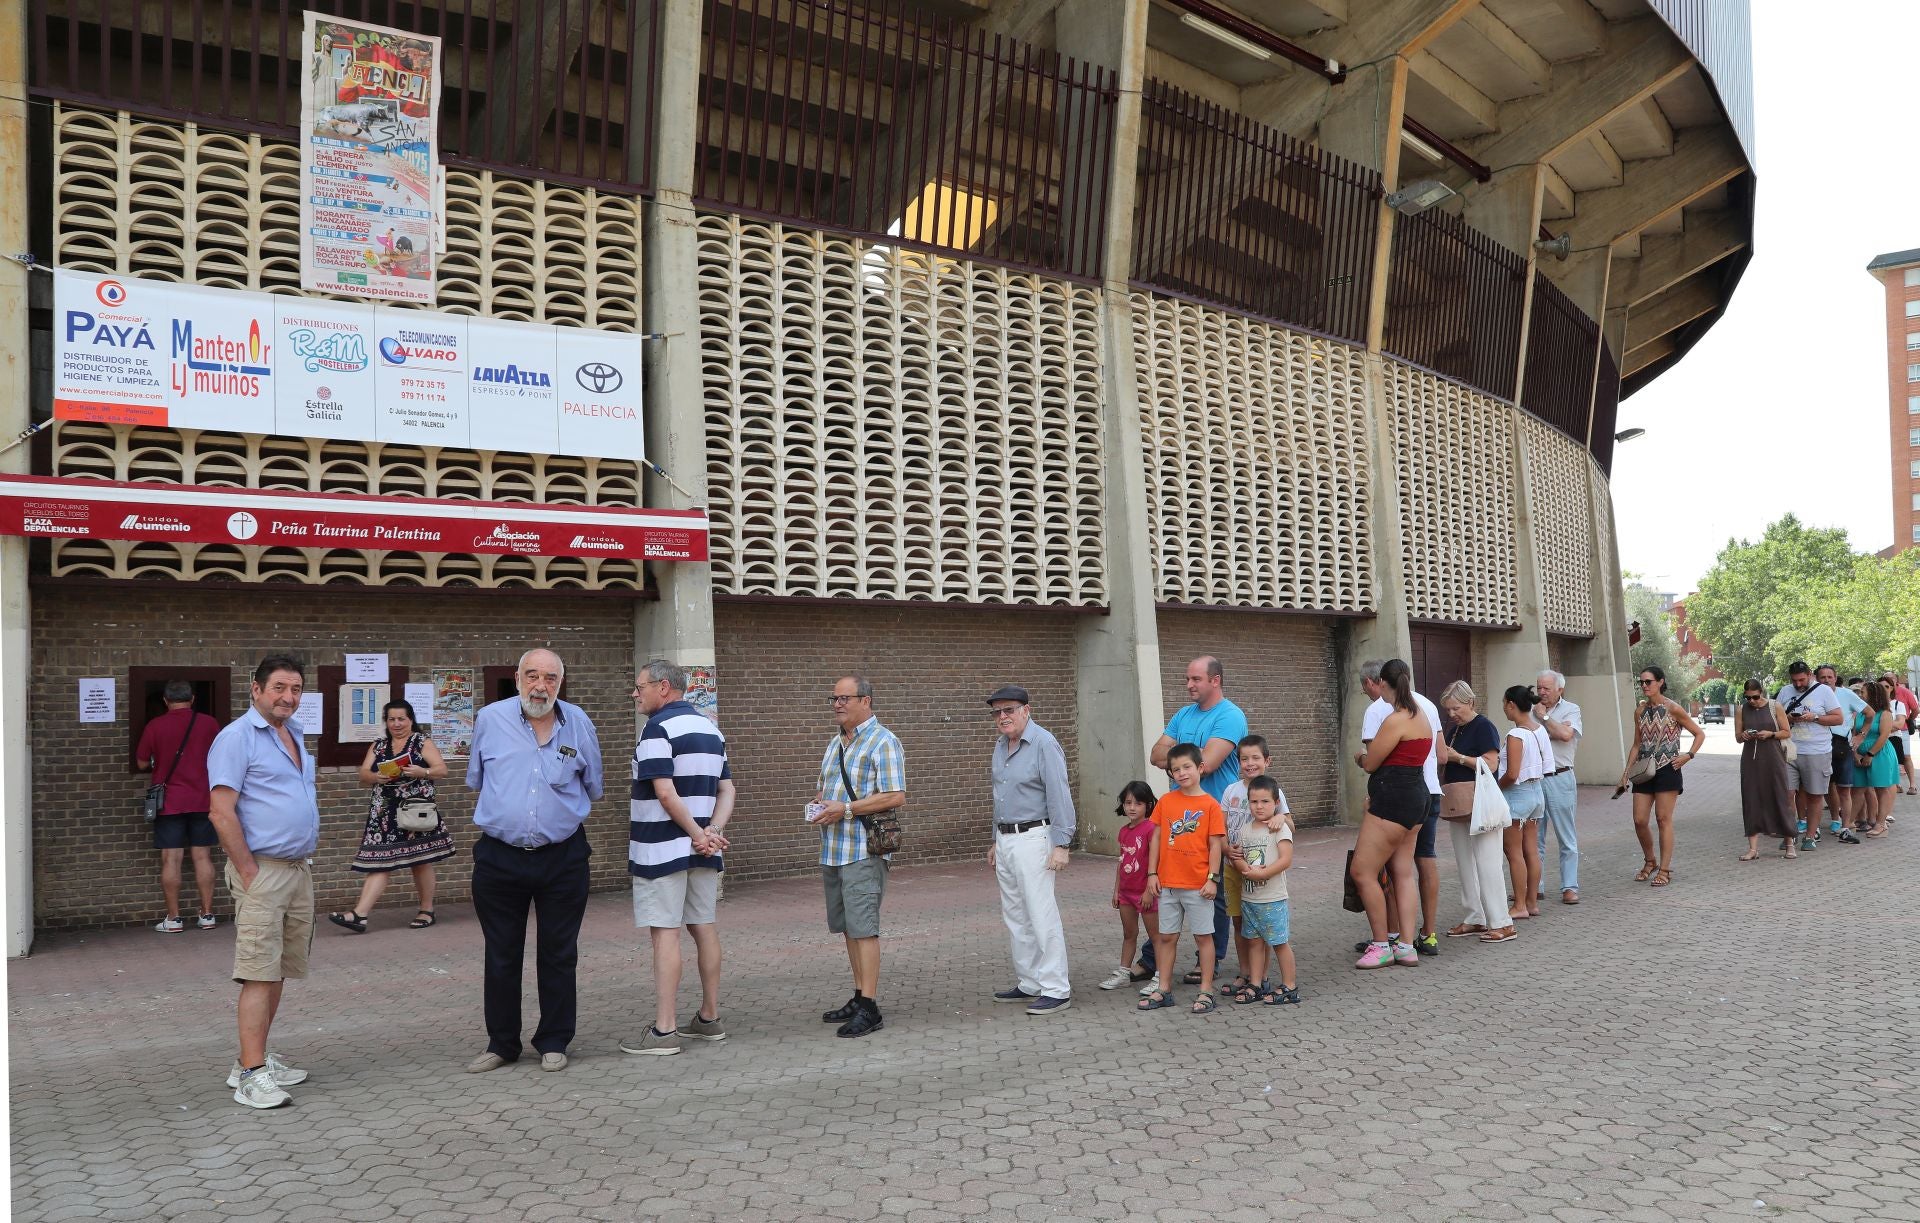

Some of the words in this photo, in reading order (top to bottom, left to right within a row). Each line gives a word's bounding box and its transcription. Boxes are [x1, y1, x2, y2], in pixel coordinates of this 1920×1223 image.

[379, 120, 416, 143] SAN
[316, 153, 343, 163] EMILIO
[333, 150, 364, 160] PERERA
[402, 150, 428, 172] 2025
[316, 160, 358, 171] CLEMENTE
[330, 181, 366, 190] FERNANDES
[316, 190, 352, 201] DUARTE
[354, 197, 385, 205] FERNANDES
[336, 187, 374, 197] VENTURA
[315, 210, 355, 220] MORANTE
[315, 216, 372, 228] MANZANARES
[336, 225, 370, 234] AGUADO
[315, 245, 362, 256] TALAVANTE
[315, 252, 339, 260] ROCA
[345, 261, 367, 269] RUFO
[315, 282, 429, 299] www.torospalencia.es
[98, 312, 143, 323] Comercial
[283, 317, 359, 332] DISTRIBUCIONES
[399, 330, 457, 347] TELECOMUNICACIONES
[288, 328, 368, 362] R&M
[63, 352, 132, 365] DISTRIBUIDOR
[136, 358, 148, 366] DE
[393, 345, 457, 361] ALVARO
[63, 362, 124, 374] PRODUCTOS
[128, 368, 153, 376] PARA
[318, 358, 360, 371] HOSTELERIA
[63, 372, 102, 382] HIGIENE
[116, 377, 160, 386] LIMPIEZA
[172, 363, 187, 397] LJ
[473, 364, 551, 387] LAVAZZA
[401, 378, 414, 387] 979
[416, 379, 425, 388] 72
[426, 381, 435, 389] 35
[437, 382, 446, 390] 75
[59, 386, 163, 400] www.comercialpaya.com
[401, 391, 414, 400] 979
[416, 392, 424, 401] 71
[427, 393, 435, 402] 11
[437, 394, 446, 402] 74
[472, 386, 516, 397] ESPRESSO
[528, 390, 553, 399] POINT
[305, 399, 343, 411] Estrella
[564, 402, 637, 420] PALENCIA
[306, 409, 342, 421] Galicia
[402, 419, 418, 427] 34002
[421, 420, 446, 429] PALENCIA
[58, 503, 89, 511] TAURINOS
[24, 518, 52, 526] PLAZA
[134, 522, 191, 532] eumenio
[24, 525, 89, 534] DEPALENCIA.ES
[271, 521, 307, 536] Peña
[313, 523, 369, 538] Taurina
[373, 525, 441, 541] Palentina
[496, 531, 540, 540] asociación
[473, 534, 509, 548] Cultural
[509, 538, 540, 549] Taurina
[581, 541, 624, 550] eumenio
[644, 550, 690, 558] DEPALENCIA.ES
